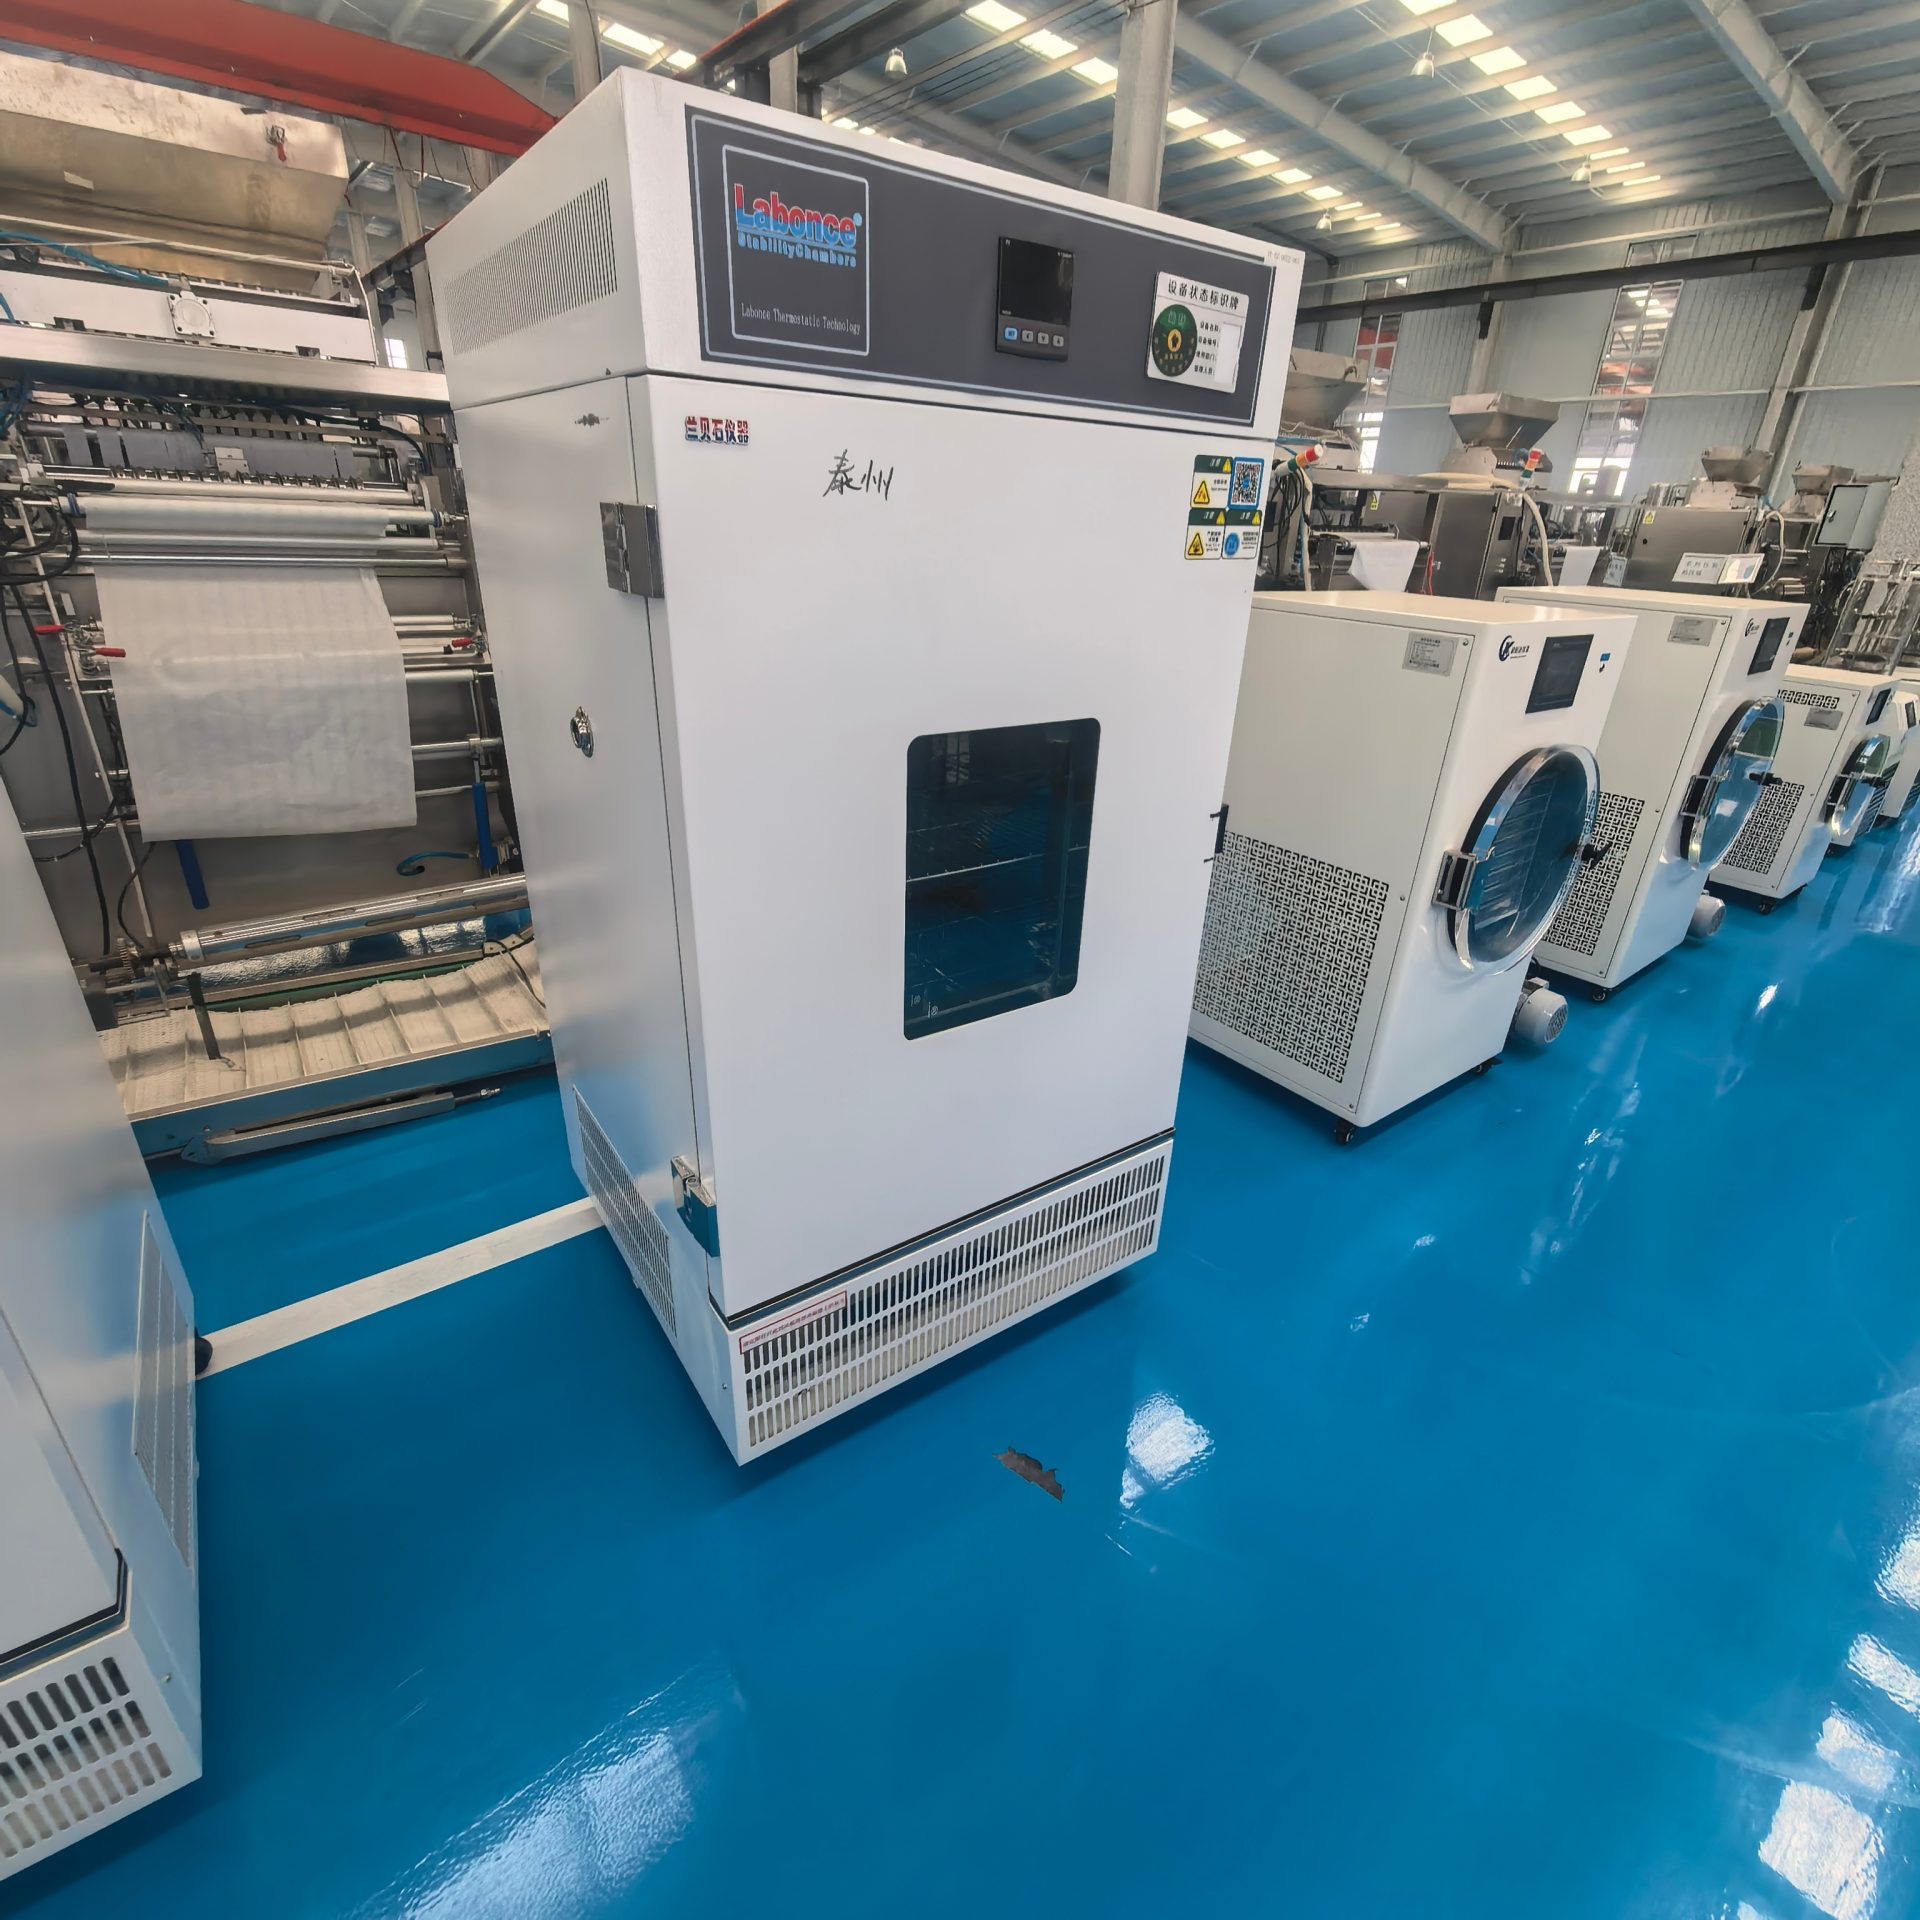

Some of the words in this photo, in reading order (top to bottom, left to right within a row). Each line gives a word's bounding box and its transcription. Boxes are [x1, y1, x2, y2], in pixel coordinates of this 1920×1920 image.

[734, 183, 857, 249] Labonce
[1168, 279, 1239, 310] 设备状态标识牌
[741, 302, 771, 321] Labonce
[773, 307, 821, 328] Thermostatic
[822, 315, 861, 335] Technology
[685, 416, 749, 445] 兰贝石仪器
